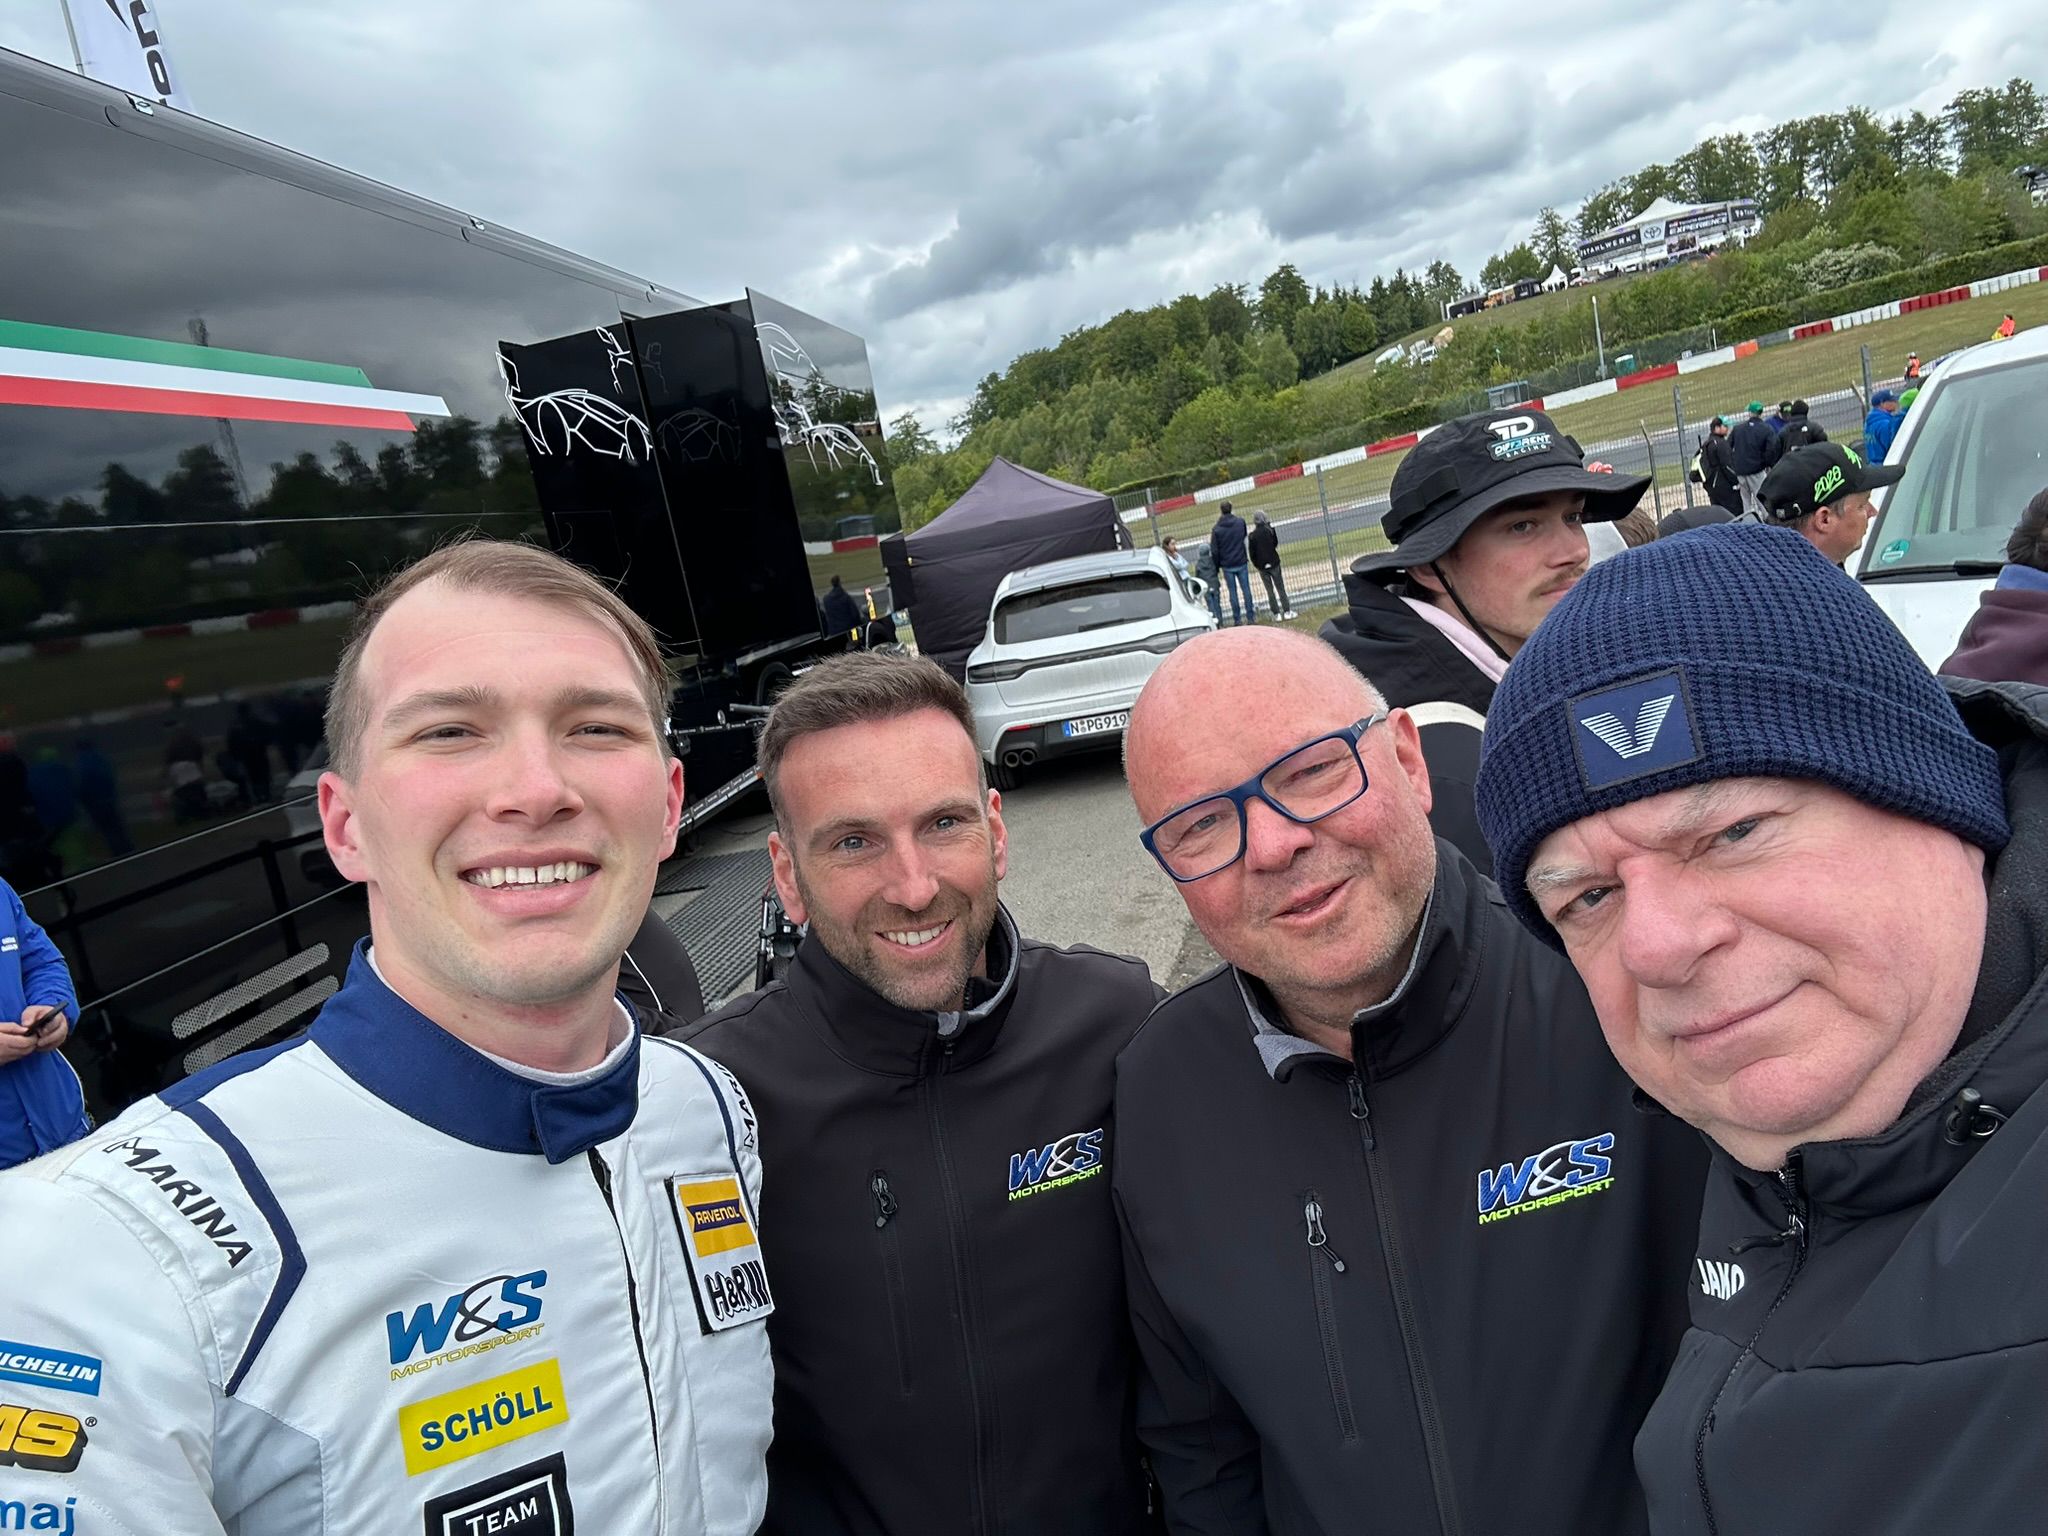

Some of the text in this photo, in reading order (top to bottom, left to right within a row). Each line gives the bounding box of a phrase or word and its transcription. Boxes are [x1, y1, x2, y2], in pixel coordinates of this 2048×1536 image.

[1070, 721, 1080, 735] N
[1008, 1128, 1104, 1191] W&S
[1008, 1164, 1104, 1202] MOTORSPORT
[1477, 1132, 1616, 1213] W&S
[102, 1136, 254, 1269] MARINA
[694, 1204, 741, 1226] RAVENOL
[1478, 1177, 1616, 1226] MOTORSPORT
[1696, 1257, 1746, 1302] JAKO
[386, 1269, 548, 1365] W&S
[390, 1322, 546, 1382] MOTORSPORT
[419, 1386, 554, 1453] SCHÖLL
[464, 1496, 540, 1536] TEAM
